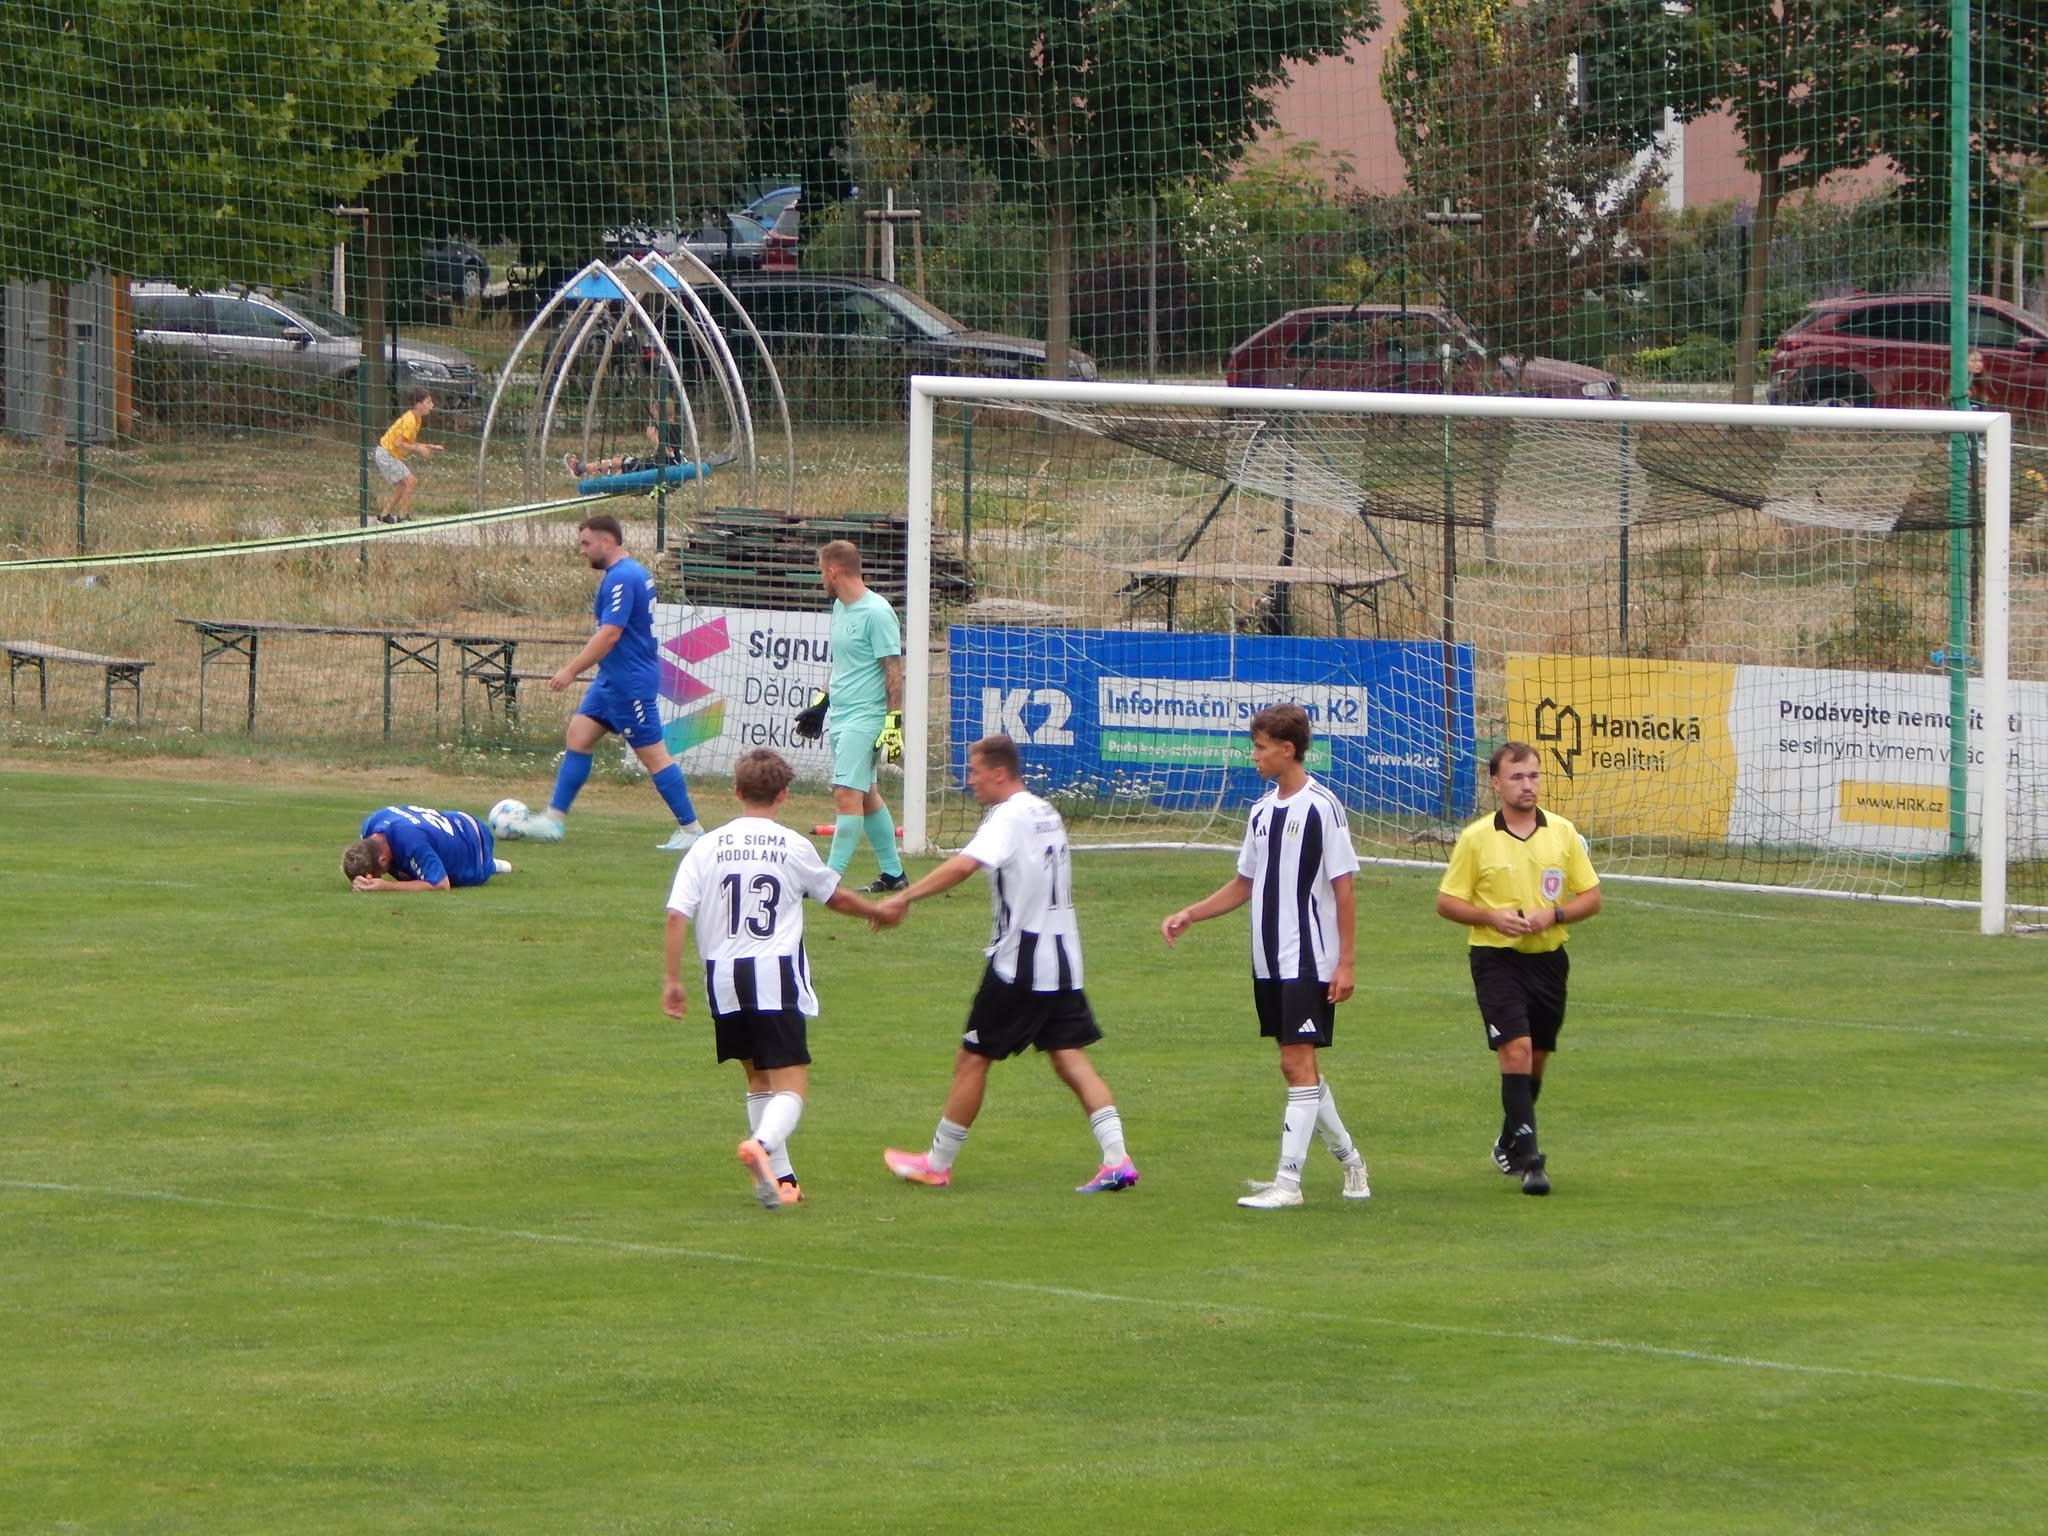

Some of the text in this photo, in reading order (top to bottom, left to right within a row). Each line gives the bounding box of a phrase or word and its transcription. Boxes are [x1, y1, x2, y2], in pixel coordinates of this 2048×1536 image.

[749, 627, 833, 670] Signu
[982, 687, 1074, 746] K2
[1107, 688, 1231, 718] Informační
[1327, 698, 1359, 723] K2
[1779, 699, 1892, 728] Prodávejte
[1591, 747, 1665, 772] realitní
[1779, 738, 1798, 753] se
[1803, 736, 1863, 760] silným
[1868, 740, 1935, 763] týmem
[1857, 796, 1943, 813] www.HRK.cz
[718, 834, 787, 848] FC SIGMA
[716, 849, 788, 865] HODOLANY
[720, 873, 781, 941] 13
